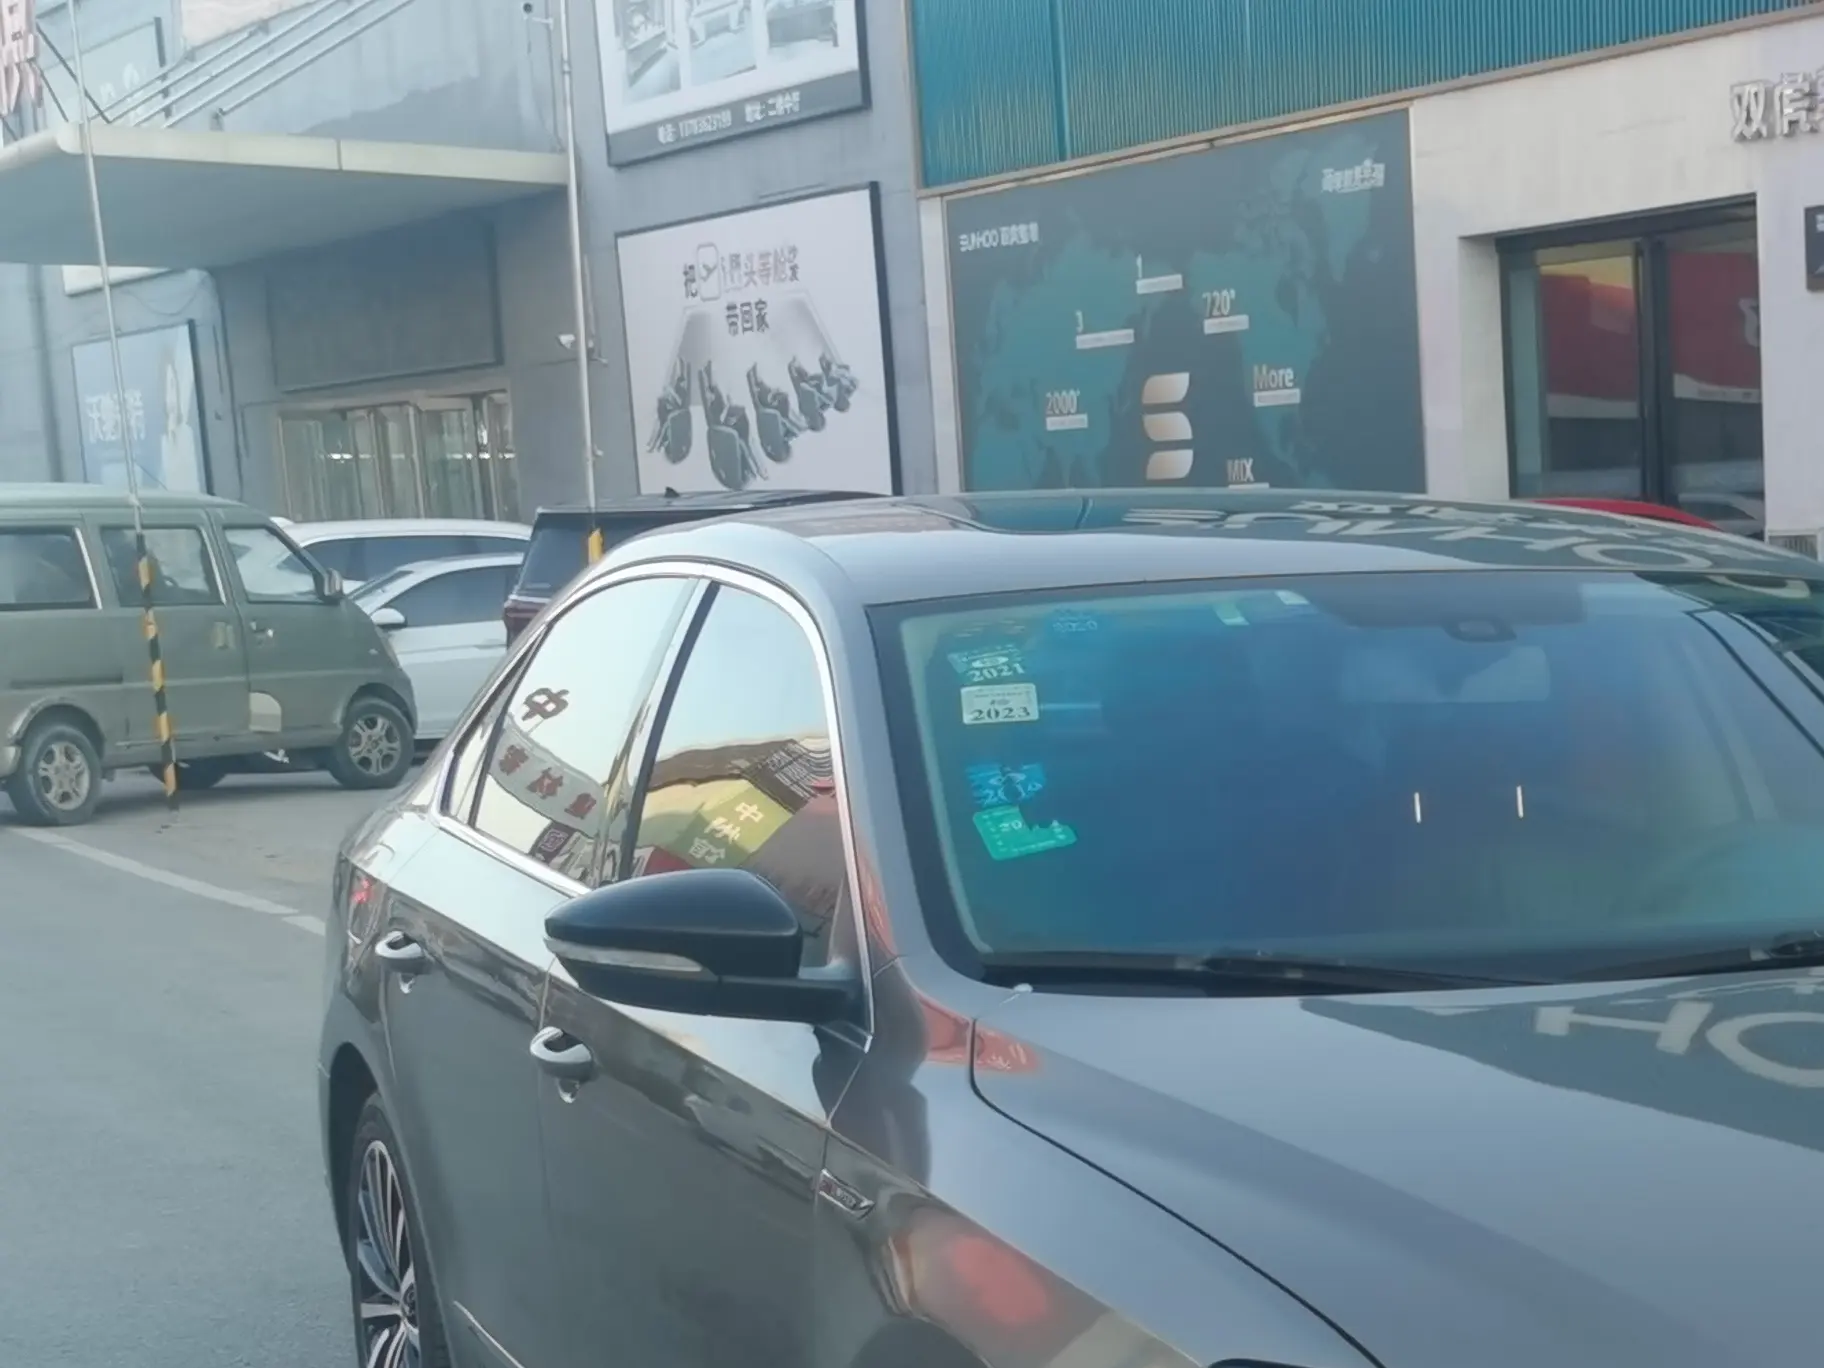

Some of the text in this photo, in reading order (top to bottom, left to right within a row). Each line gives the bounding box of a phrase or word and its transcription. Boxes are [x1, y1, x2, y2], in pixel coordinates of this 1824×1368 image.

[1253, 363, 1294, 389] More
[1227, 457, 1255, 482] MIX
[968, 663, 1025, 682] 2021
[969, 706, 1031, 722] 2023
